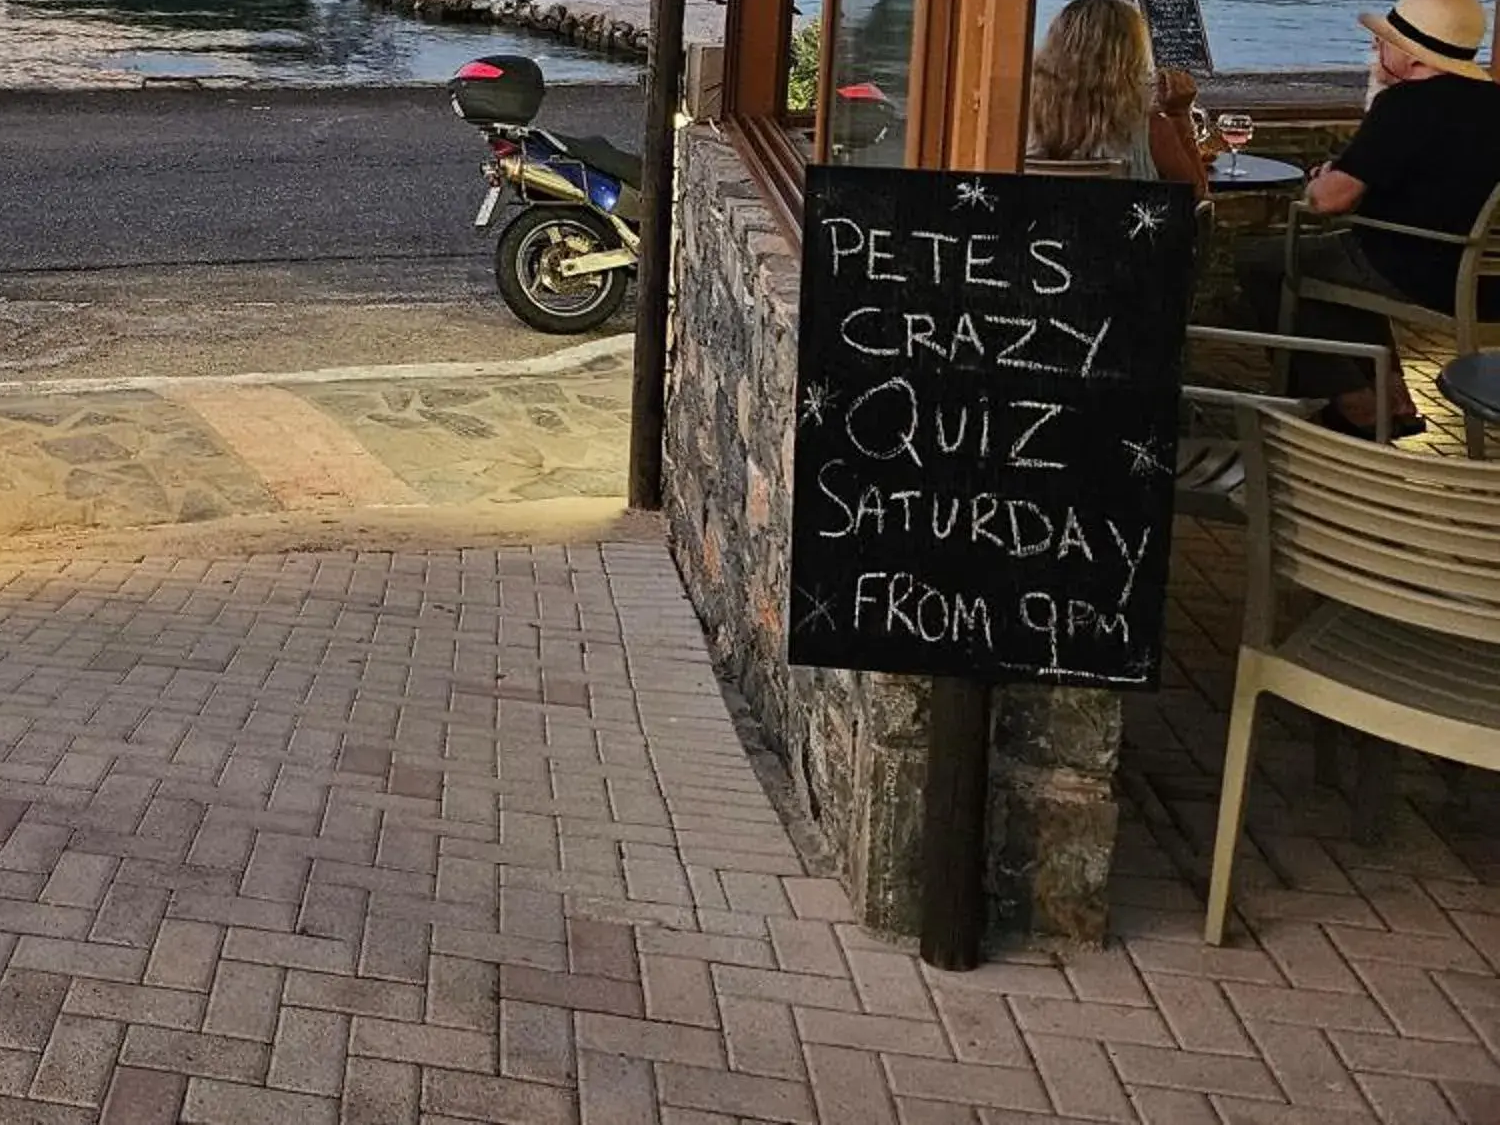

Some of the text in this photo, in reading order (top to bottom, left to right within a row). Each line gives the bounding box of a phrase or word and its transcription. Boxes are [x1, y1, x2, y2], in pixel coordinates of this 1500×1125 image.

[822, 218, 1072, 294] PETE'S
[841, 307, 1112, 377] CRAZY
[819, 460, 1150, 607] SATURDAY
[853, 573, 1129, 668] FROM 9PM
